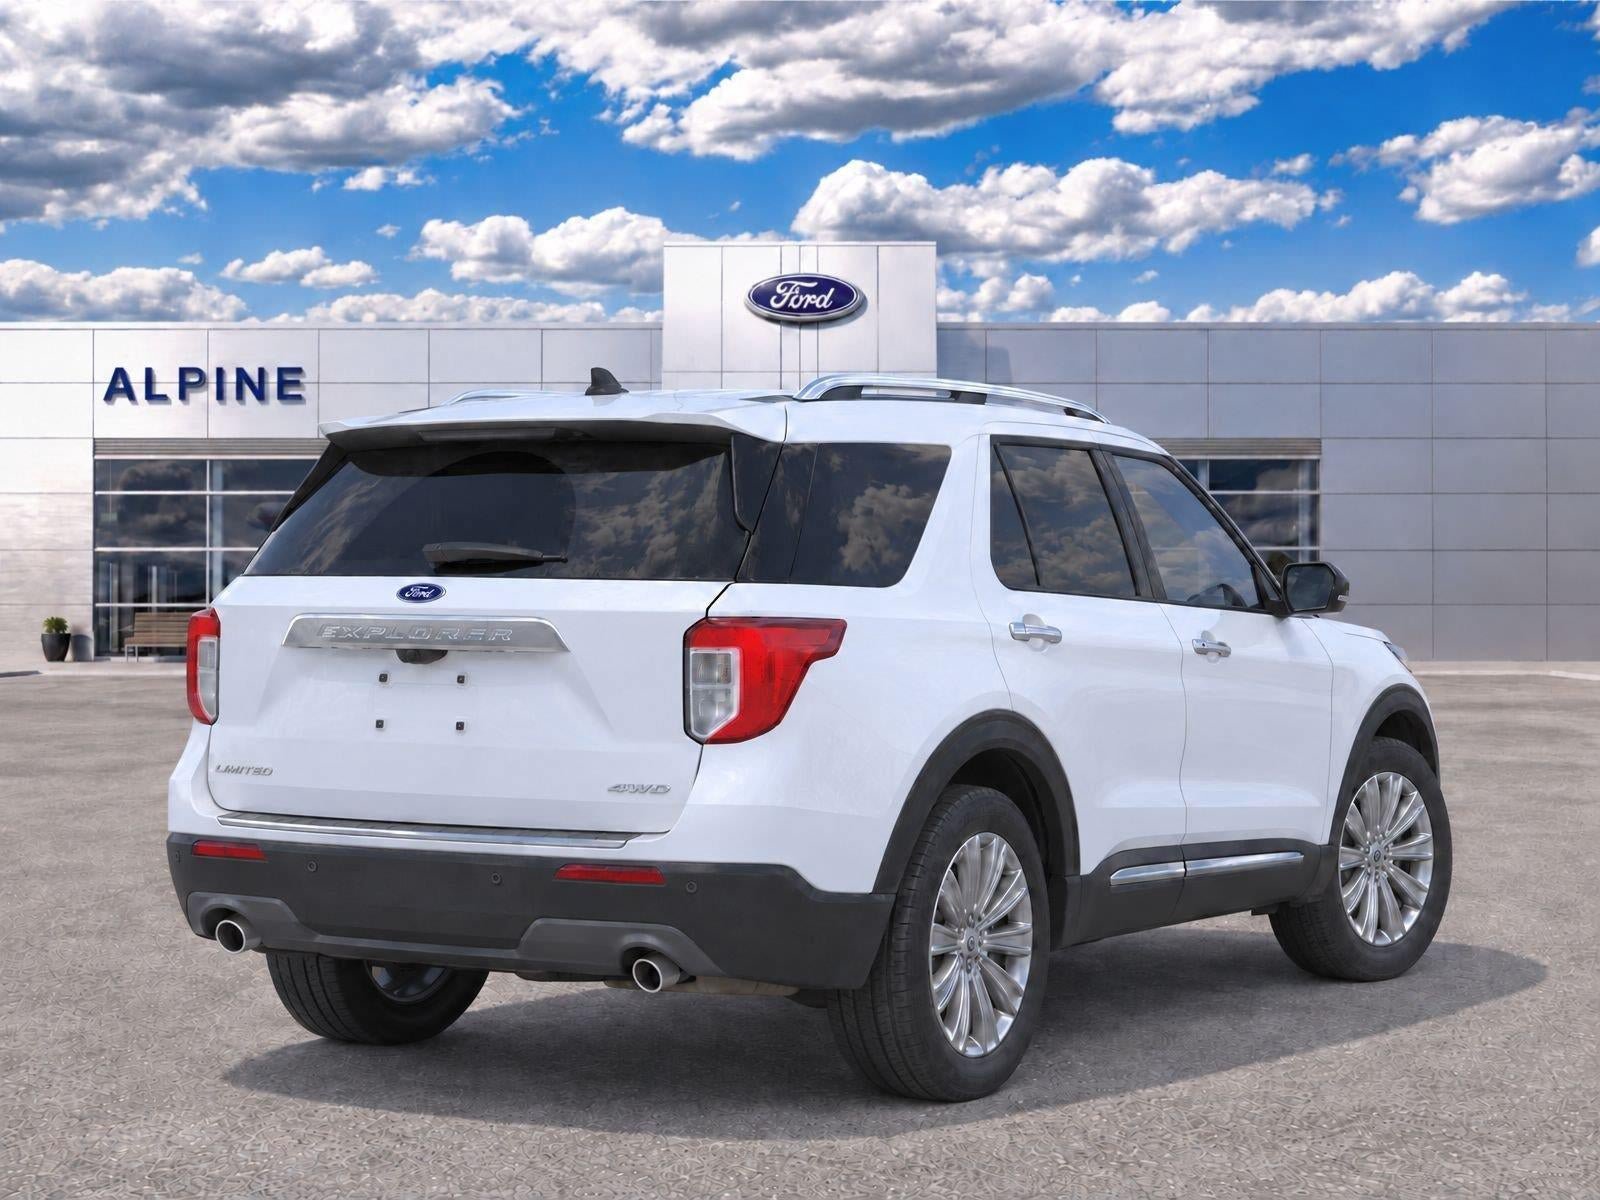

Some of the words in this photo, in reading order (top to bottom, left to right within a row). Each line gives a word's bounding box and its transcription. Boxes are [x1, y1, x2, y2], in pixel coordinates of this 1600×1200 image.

[769, 280, 836, 309] Ford
[103, 366, 304, 403] ALPINE
[404, 585, 435, 598] Ford
[319, 624, 514, 642] EXPLORER
[215, 764, 274, 777] LIMITED
[607, 783, 672, 795] 4WD
